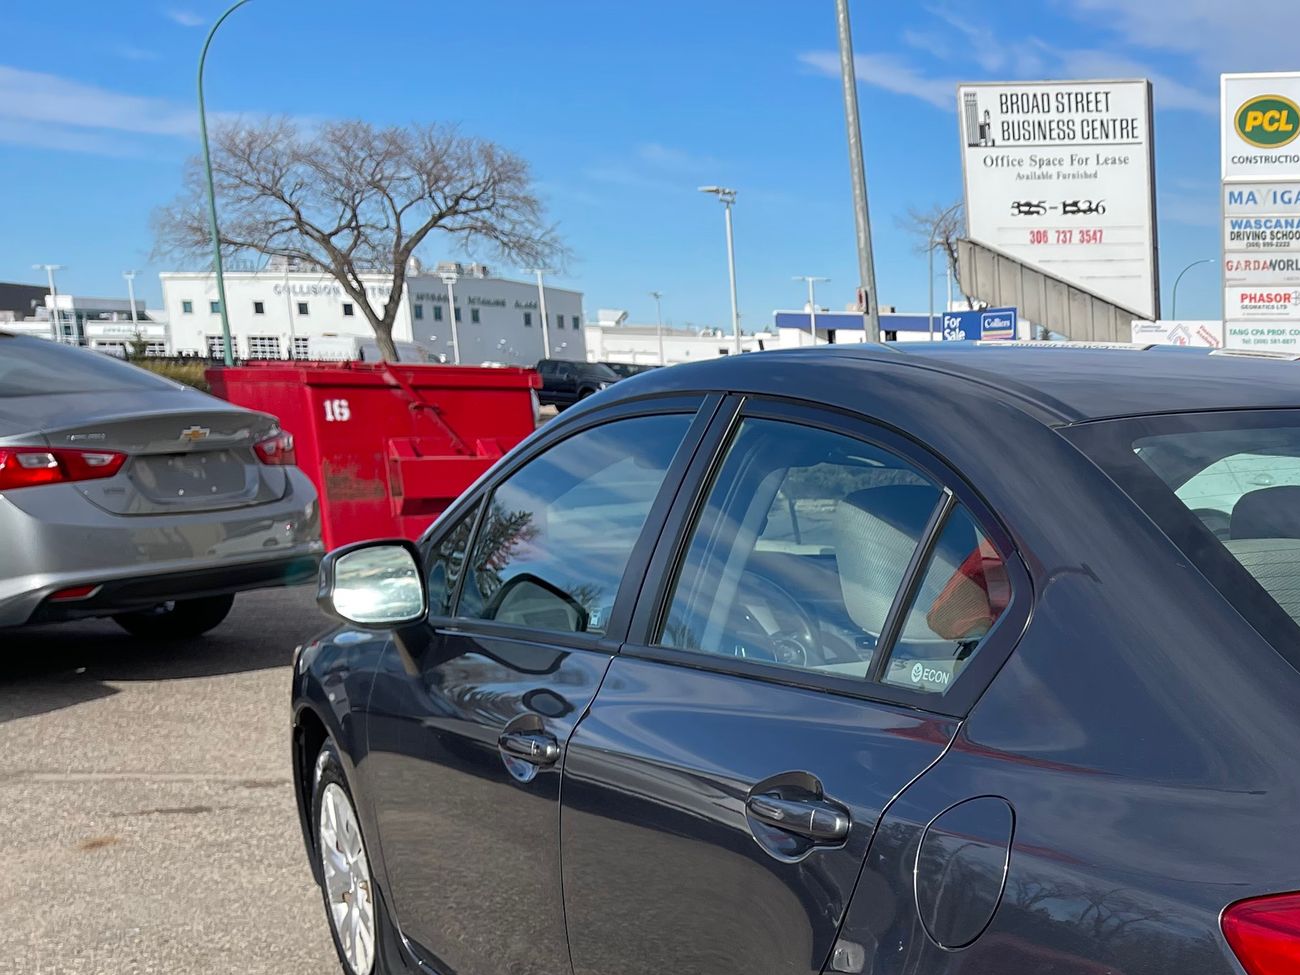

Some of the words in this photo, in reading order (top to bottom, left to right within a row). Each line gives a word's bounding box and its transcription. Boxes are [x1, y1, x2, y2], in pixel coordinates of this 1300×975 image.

[999, 92, 1051, 115] BROAD
[1055, 91, 1111, 114] STREET
[1245, 109, 1294, 133] PCL
[1001, 119, 1076, 142] BUSINESS
[1080, 118, 1139, 140] CENTRE
[983, 154, 1024, 168] Office
[1028, 154, 1065, 169] Space
[1070, 153, 1090, 166] For
[1096, 153, 1130, 166] Lease
[1015, 171, 1053, 181] Available
[1056, 170, 1098, 180] Furnished
[1029, 230, 1049, 244] 306
[1055, 229, 1073, 244] 737
[1079, 228, 1103, 243] 3547
[1230, 230, 1267, 241] DRIVING
[1240, 292, 1291, 303] PHASOR
[944, 315, 962, 329] For
[944, 328, 966, 341] Sale
[323, 398, 351, 422] 16
[922, 668, 950, 685] ECON
